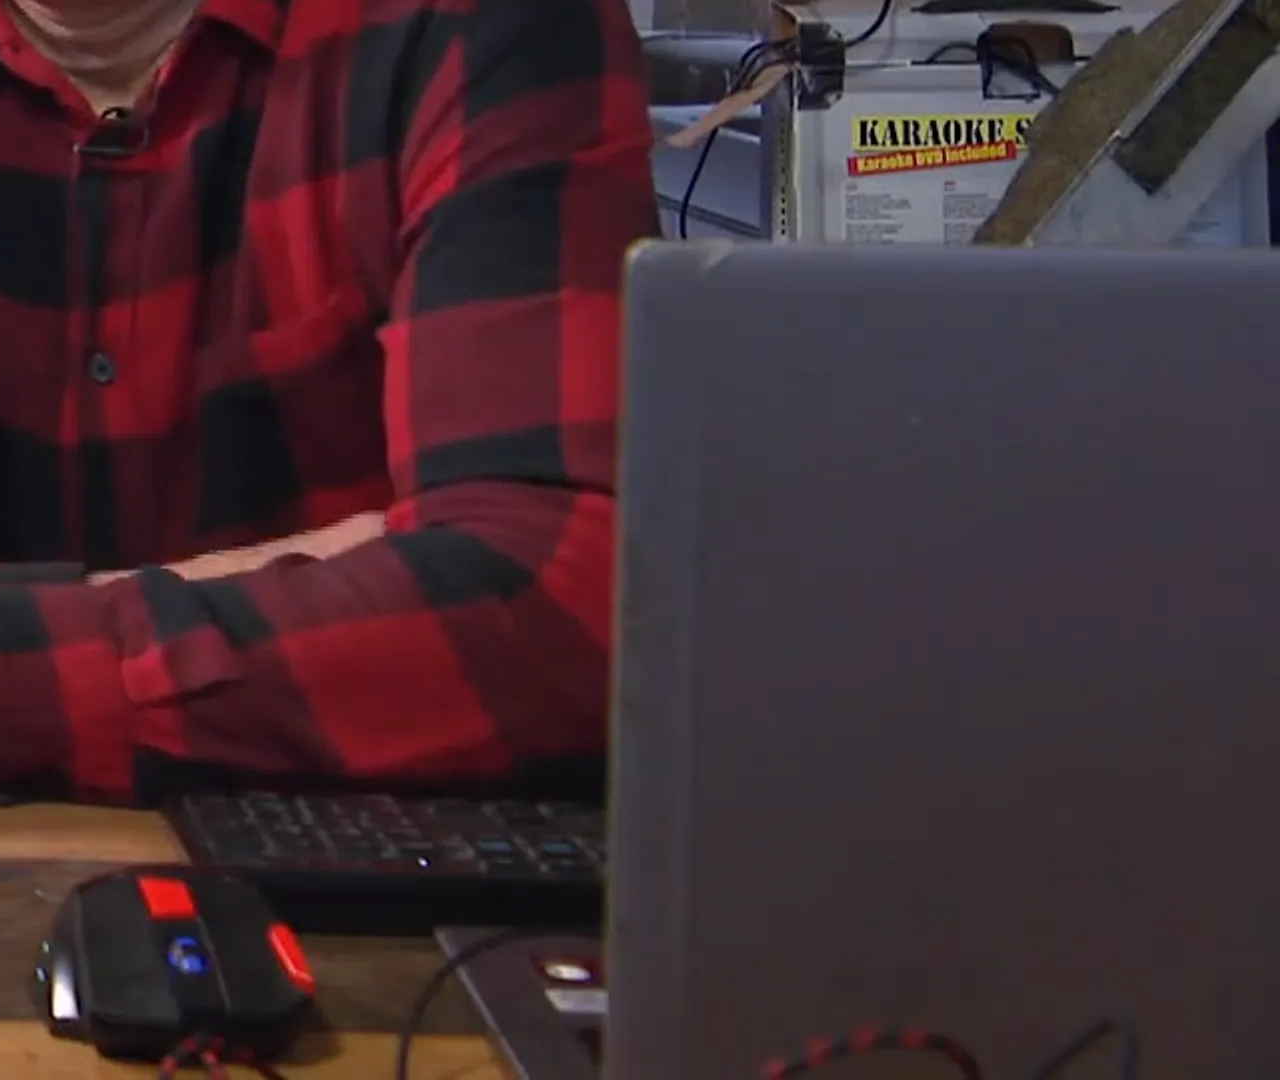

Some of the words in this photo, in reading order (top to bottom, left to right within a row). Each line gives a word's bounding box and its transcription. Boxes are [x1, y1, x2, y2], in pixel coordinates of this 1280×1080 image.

[859, 119, 1005, 146] KARAOKE
[1015, 119, 1034, 146] S
[856, 153, 914, 173] Karaoke
[916, 149, 944, 166] DVD
